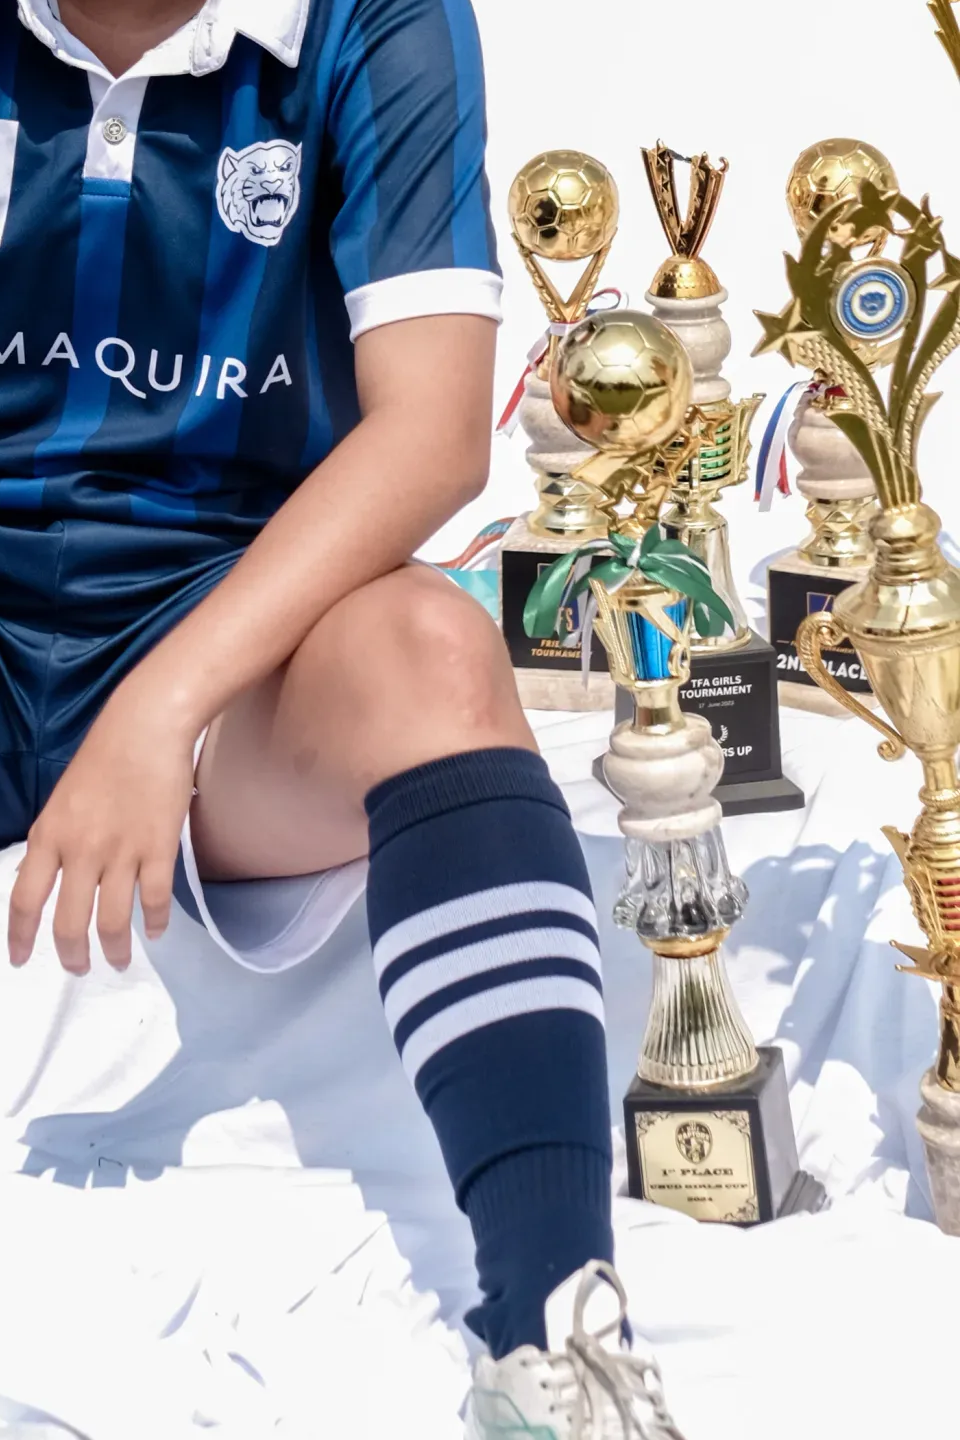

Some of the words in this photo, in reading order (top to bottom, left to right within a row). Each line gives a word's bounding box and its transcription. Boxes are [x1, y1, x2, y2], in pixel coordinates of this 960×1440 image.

[531, 648, 584, 659] TOURNAME
[821, 659, 869, 680] LACE
[691, 678, 710, 688] TFA
[712, 675, 742, 687] GIRLS
[680, 684, 752, 699] TOURNAMENT
[737, 745, 753, 756] UP
[680, 1168, 734, 1176] PLACE
